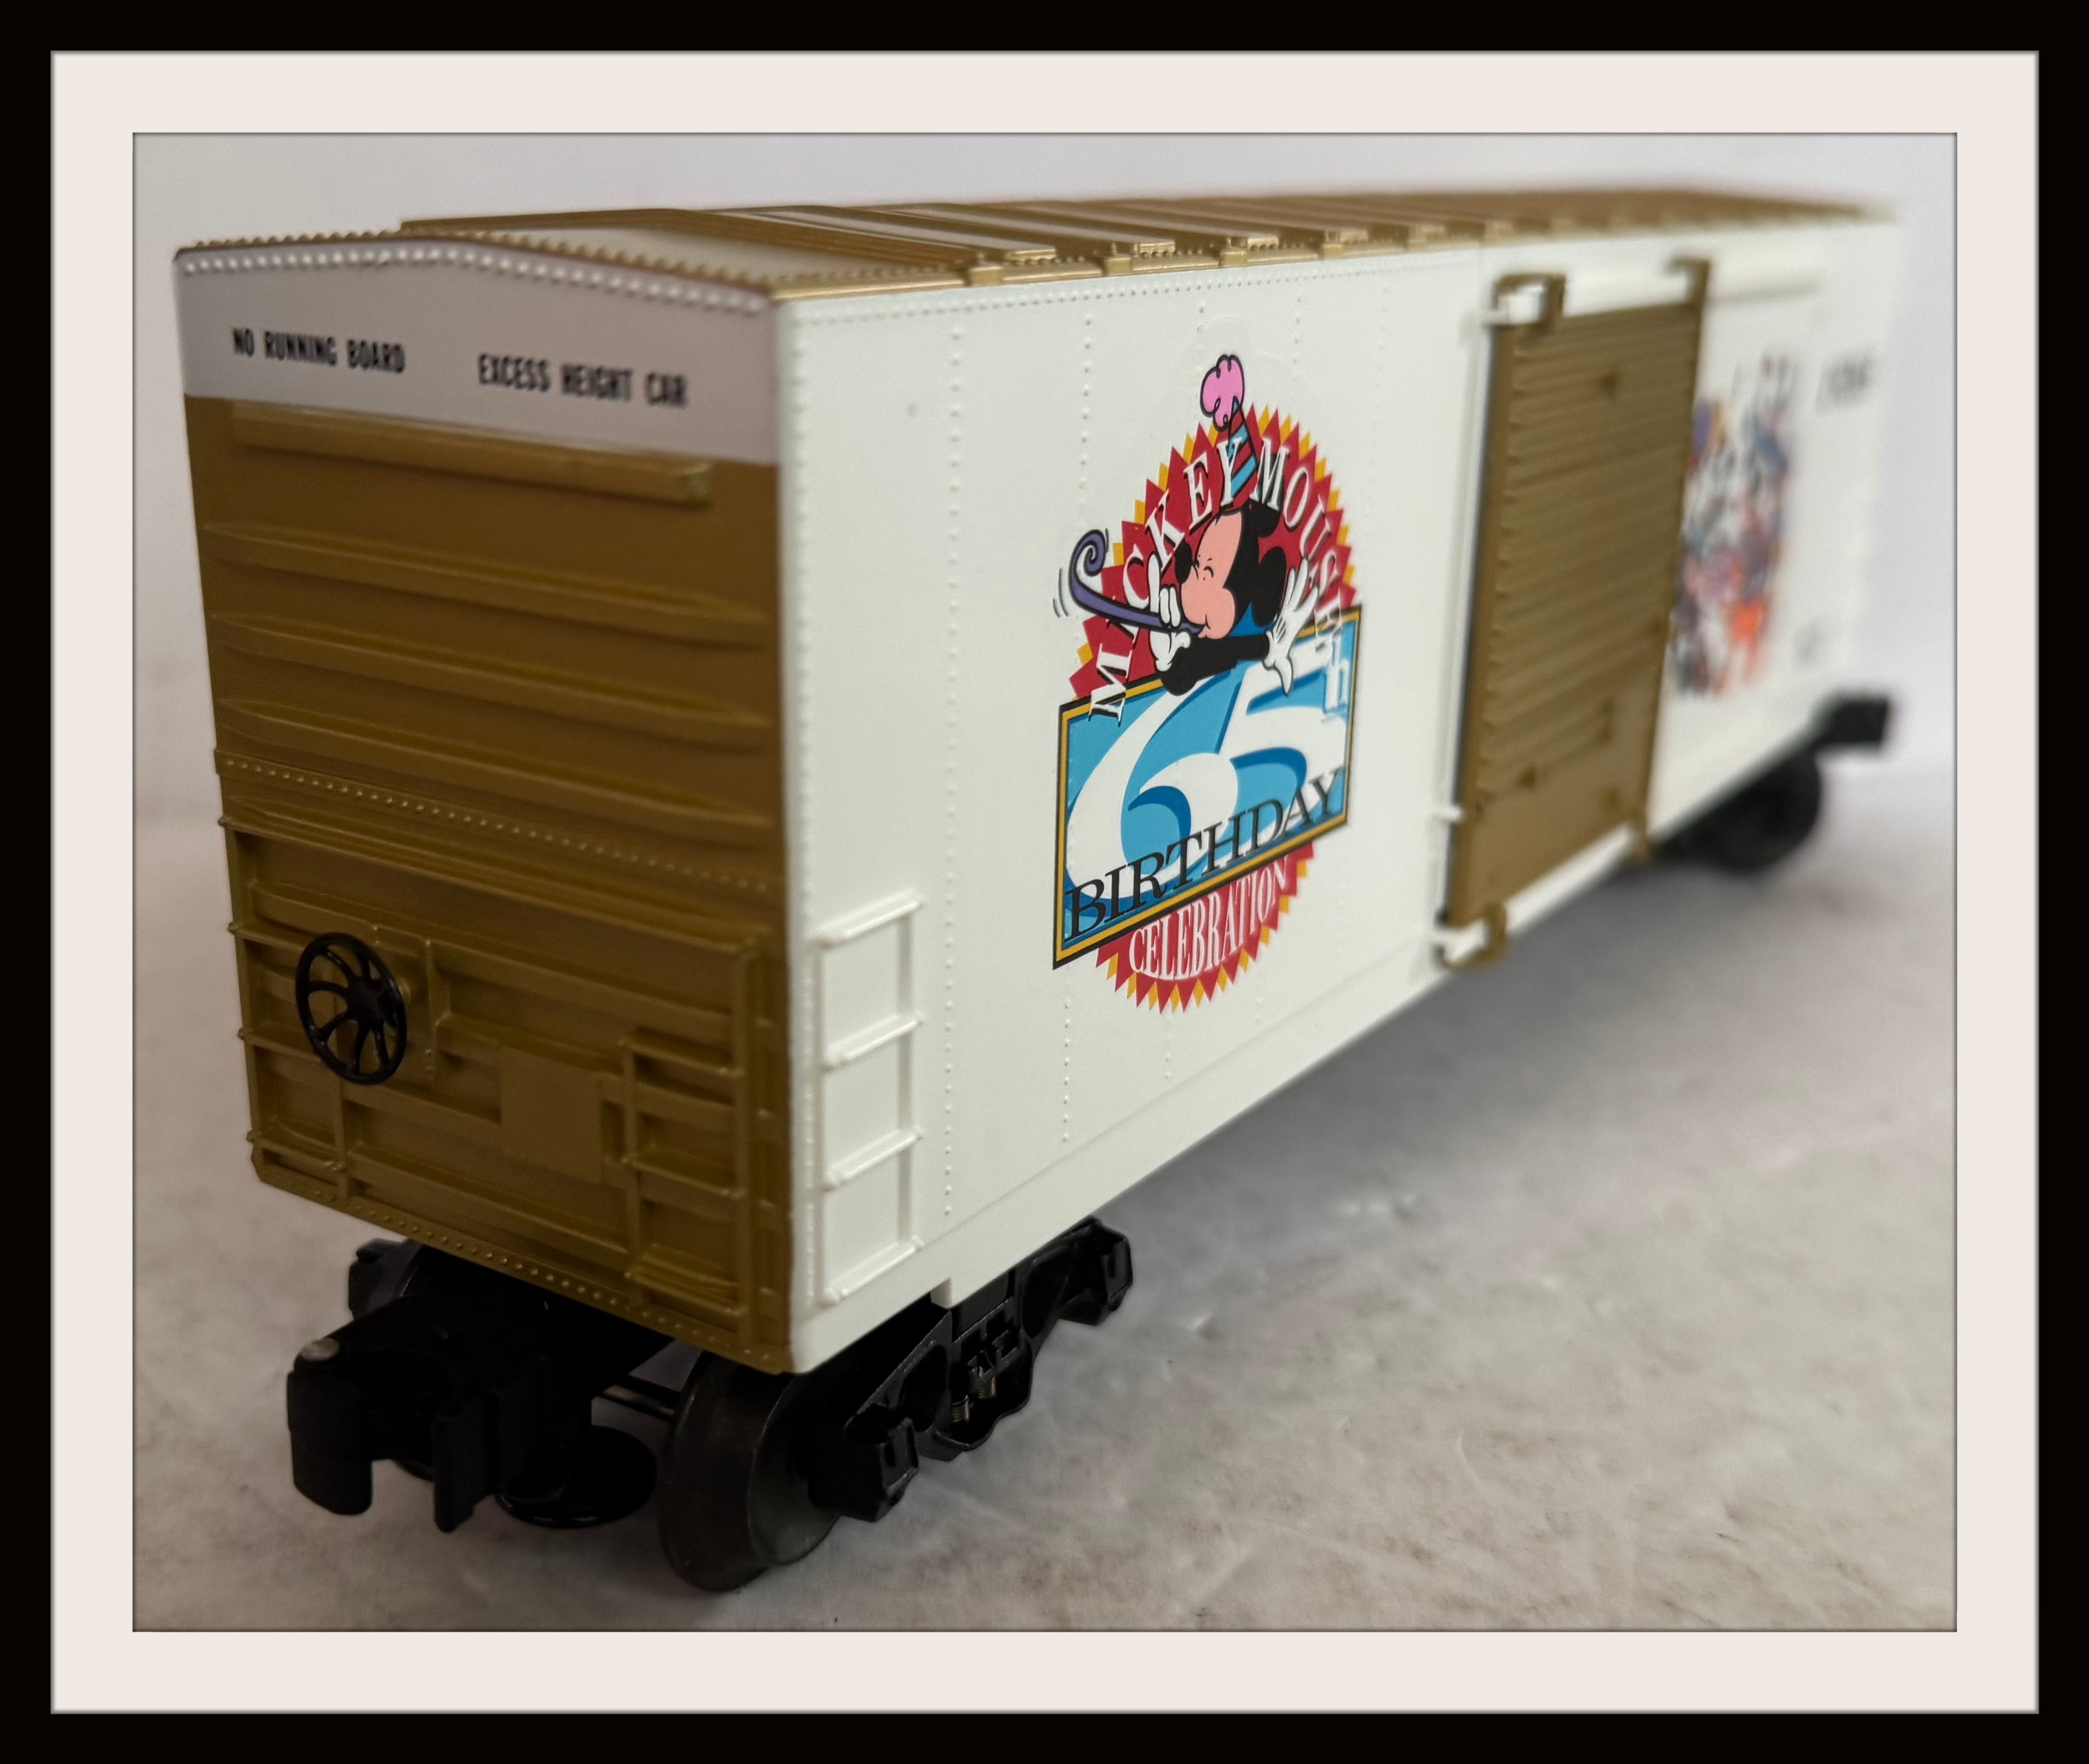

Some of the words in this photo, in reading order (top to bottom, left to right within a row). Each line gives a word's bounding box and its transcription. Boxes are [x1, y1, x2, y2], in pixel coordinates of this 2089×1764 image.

[233, 328, 255, 357] NO
[264, 330, 338, 366] RUNNING
[347, 339, 406, 374] BOARD
[479, 353, 552, 393] EXCESS
[560, 363, 633, 401] HEIGHT
[645, 372, 687, 409] CAR
[1064, 767, 1342, 941] BIRTHDAY
[1128, 854, 1288, 980] CELEBRATION
